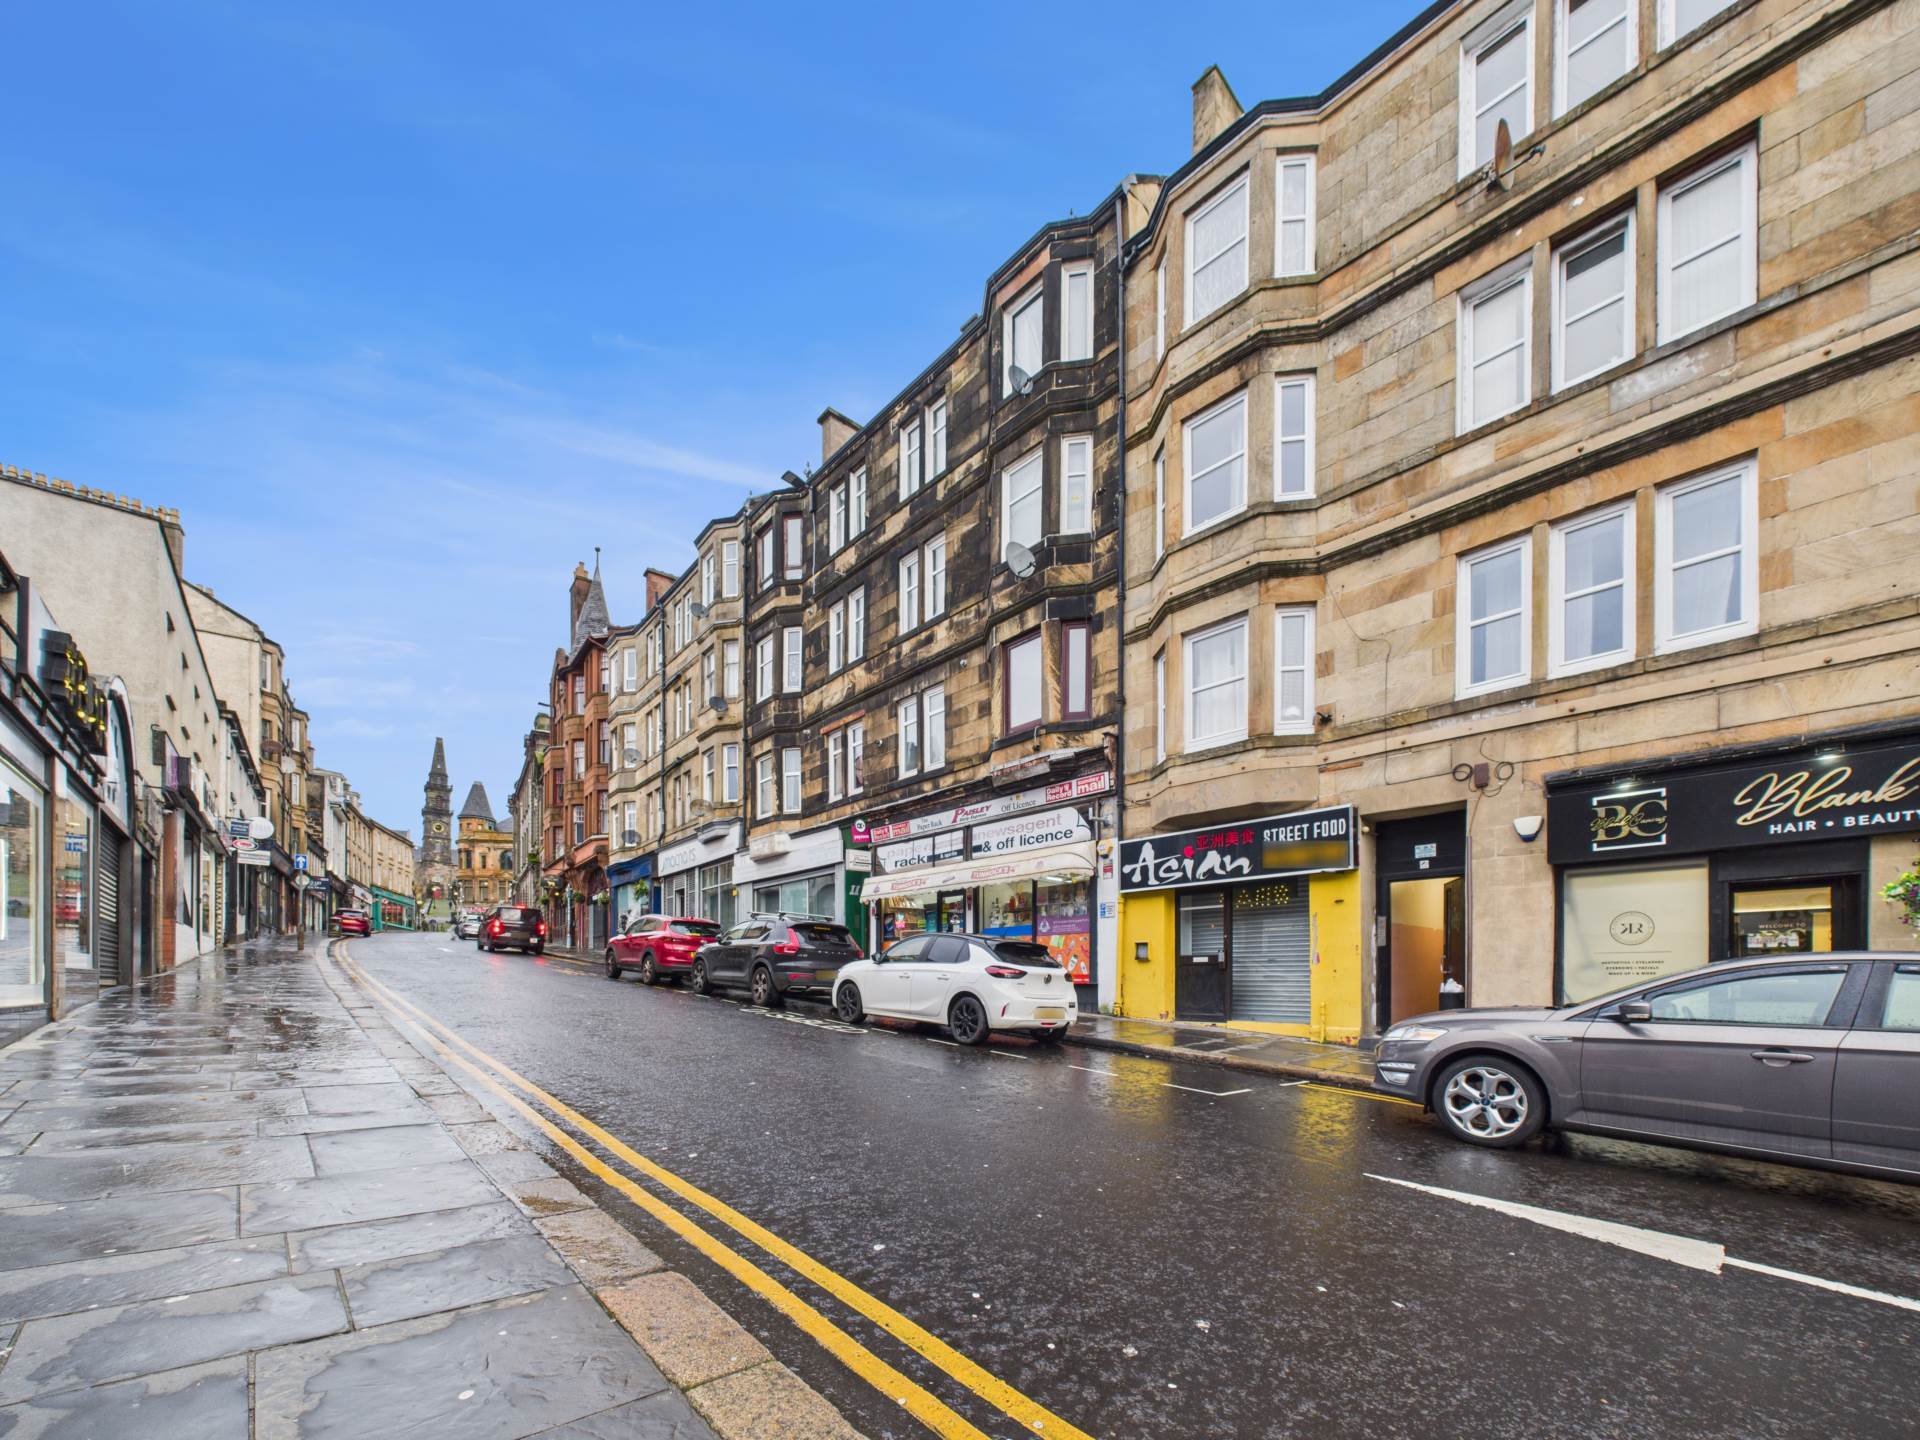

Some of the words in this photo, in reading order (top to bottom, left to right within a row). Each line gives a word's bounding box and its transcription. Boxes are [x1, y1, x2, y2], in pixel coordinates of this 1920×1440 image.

[1047, 783, 1064, 795] Daily
[1077, 775, 1104, 794] mail
[1733, 757, 1920, 827] Blank
[1047, 789, 1072, 801] Record
[1001, 802, 1012, 813] Off
[1012, 799, 1037, 810] Licence
[977, 813, 1063, 840] newsagent
[1591, 798, 1668, 842] BC
[1769, 819, 1817, 835] HAIR
[1263, 823, 1309, 842] STREET
[1313, 818, 1346, 839] FOOD
[982, 840, 992, 853] &
[996, 837, 1014, 850] off
[1019, 829, 1073, 847] licence
[894, 854, 927, 868] rack
